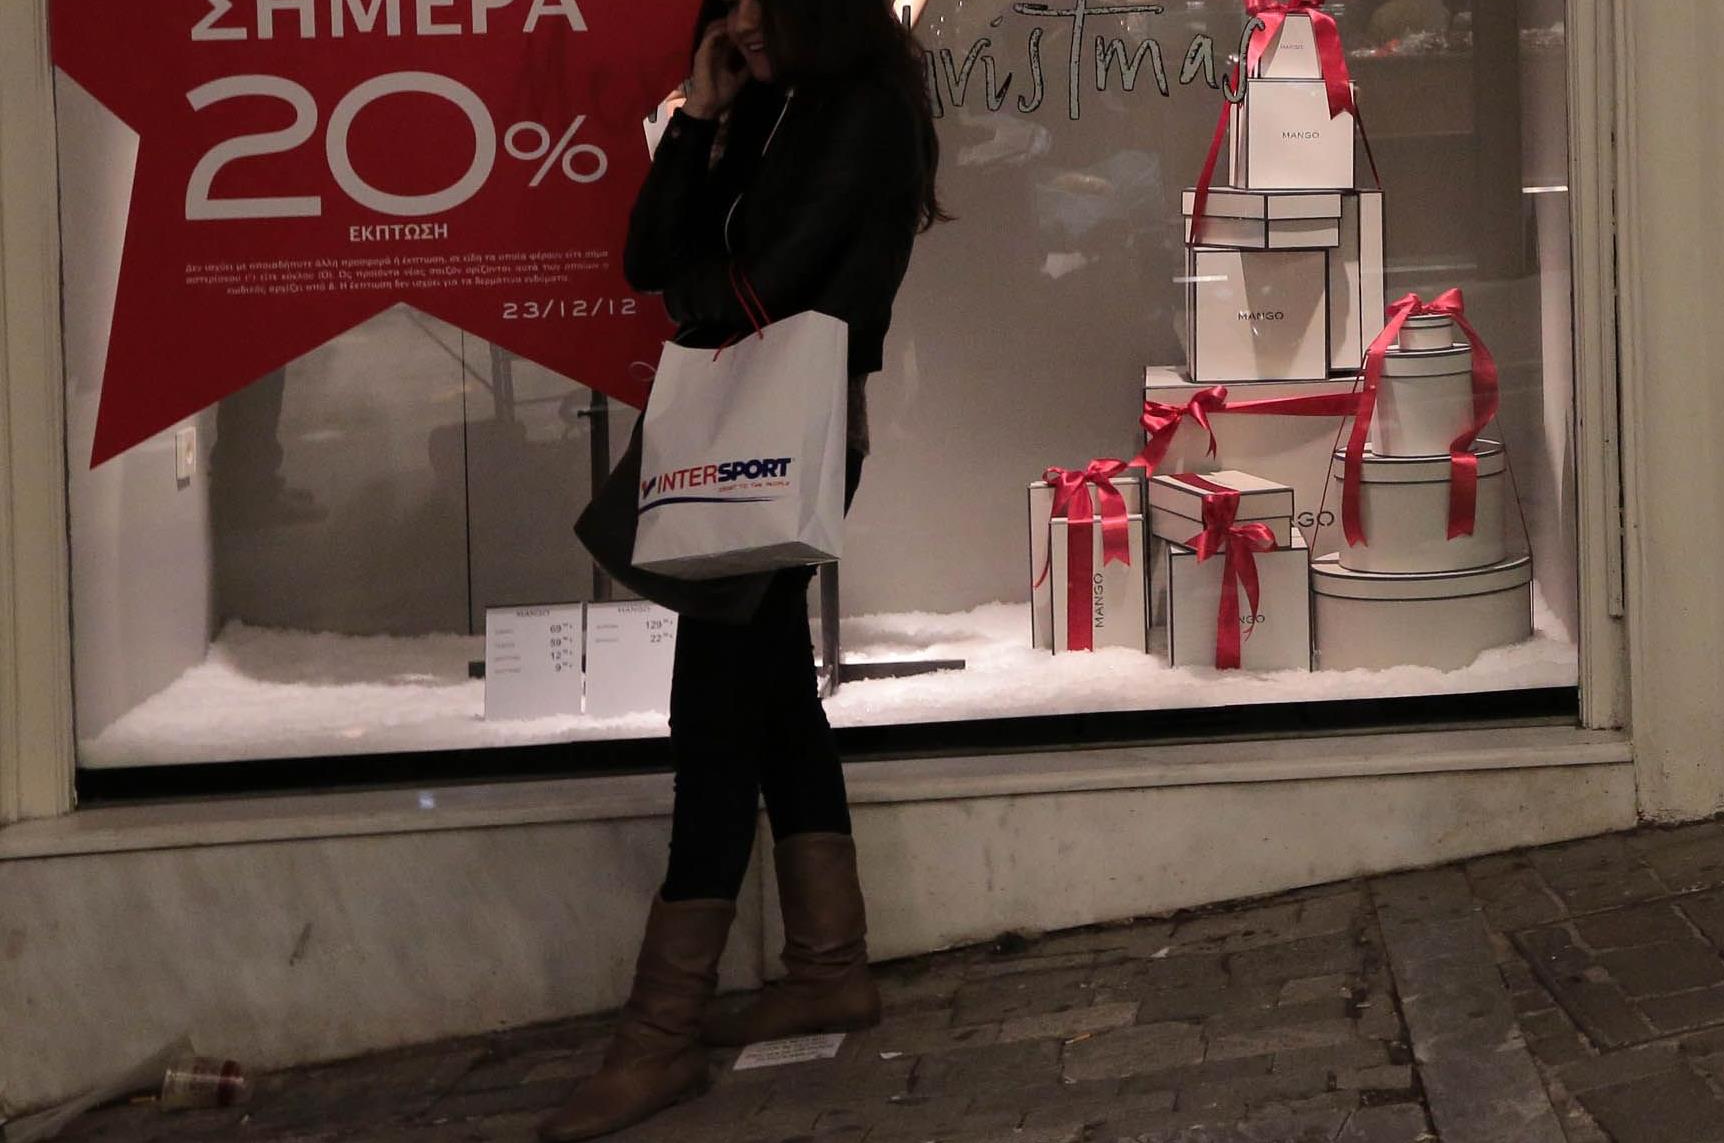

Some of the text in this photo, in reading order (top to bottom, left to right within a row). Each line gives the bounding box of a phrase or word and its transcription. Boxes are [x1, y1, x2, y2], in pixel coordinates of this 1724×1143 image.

[185, 71, 608, 220] 20%
[1282, 131, 1320, 139] MANGO
[349, 223, 448, 242] ΕΚΠΤΩΣΗ
[502, 298, 637, 319] 23/12/12
[1238, 311, 1284, 320] MANGO
[657, 458, 792, 494] INTERSPORT
[1093, 573, 1104, 628] MANGO
